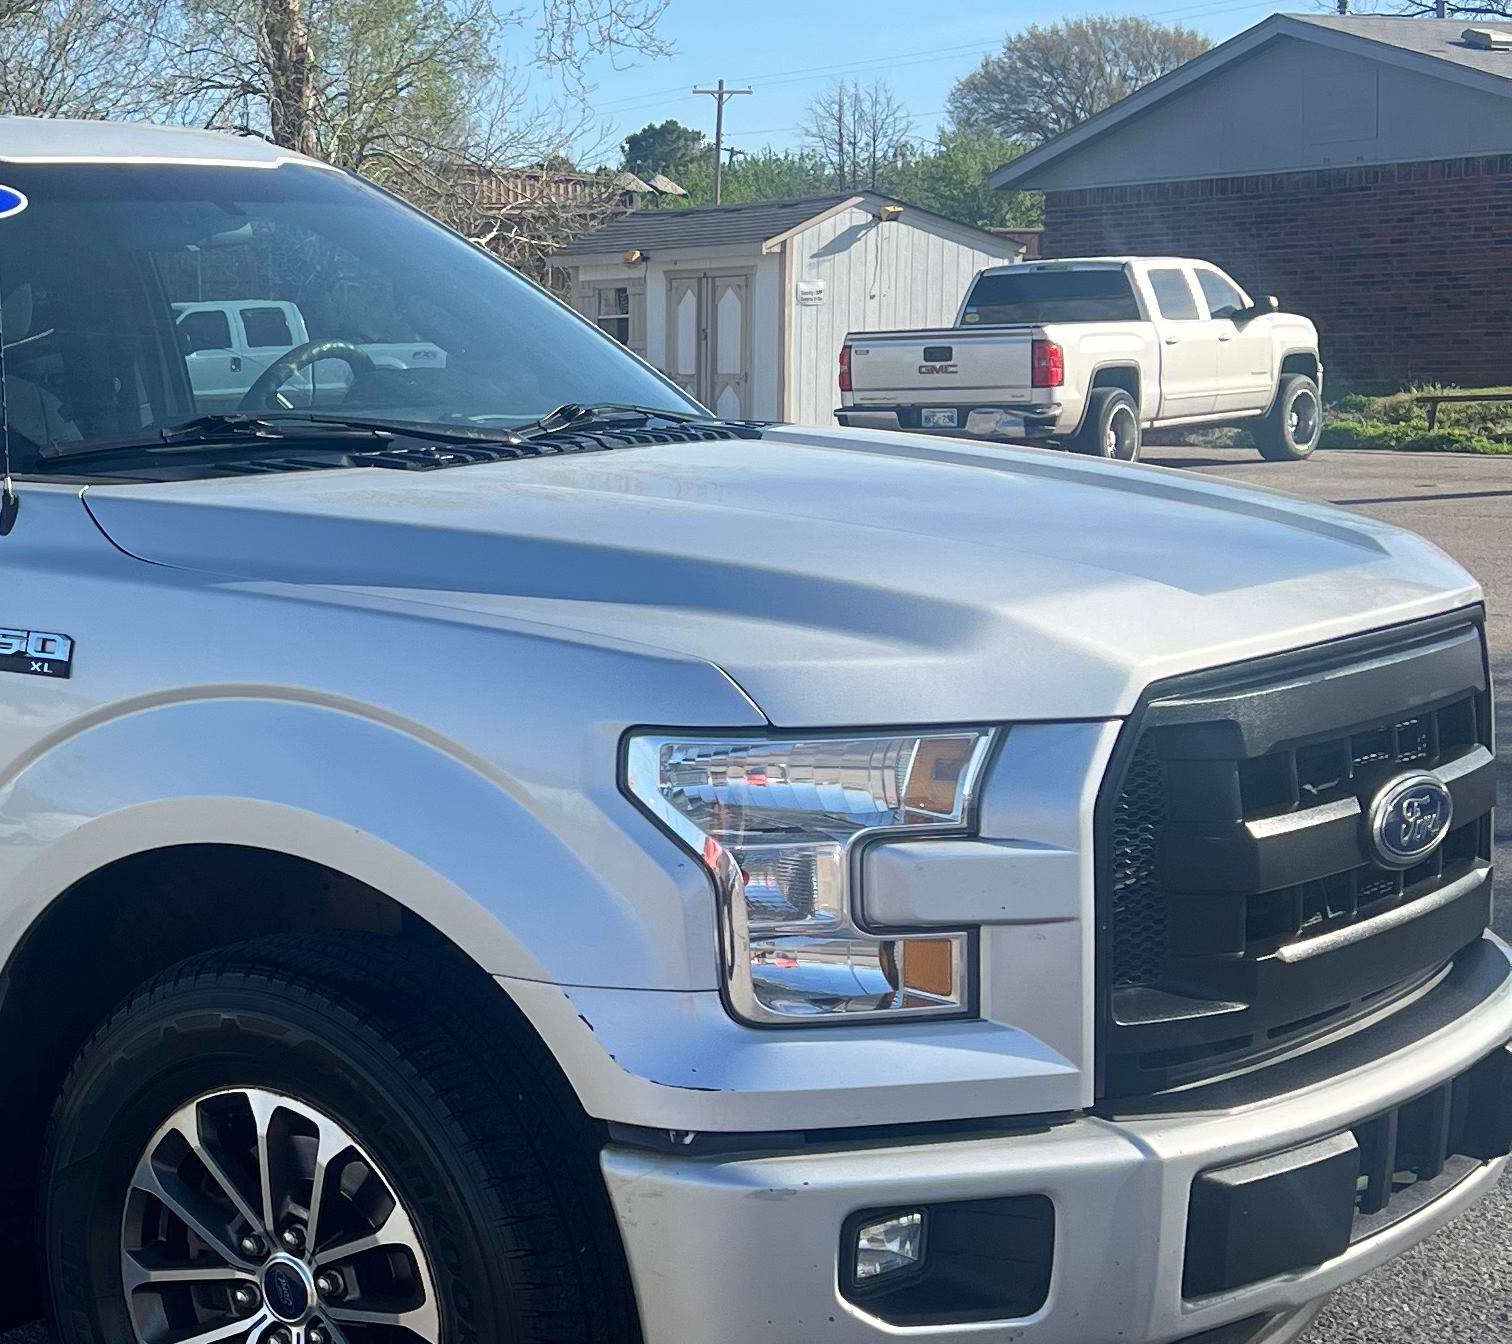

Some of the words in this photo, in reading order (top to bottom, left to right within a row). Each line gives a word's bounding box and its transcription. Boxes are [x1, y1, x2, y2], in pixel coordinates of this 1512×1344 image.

[918, 364, 959, 375] GMC
[29, 660, 54, 674] XL
[1400, 794, 1442, 846] Ford
